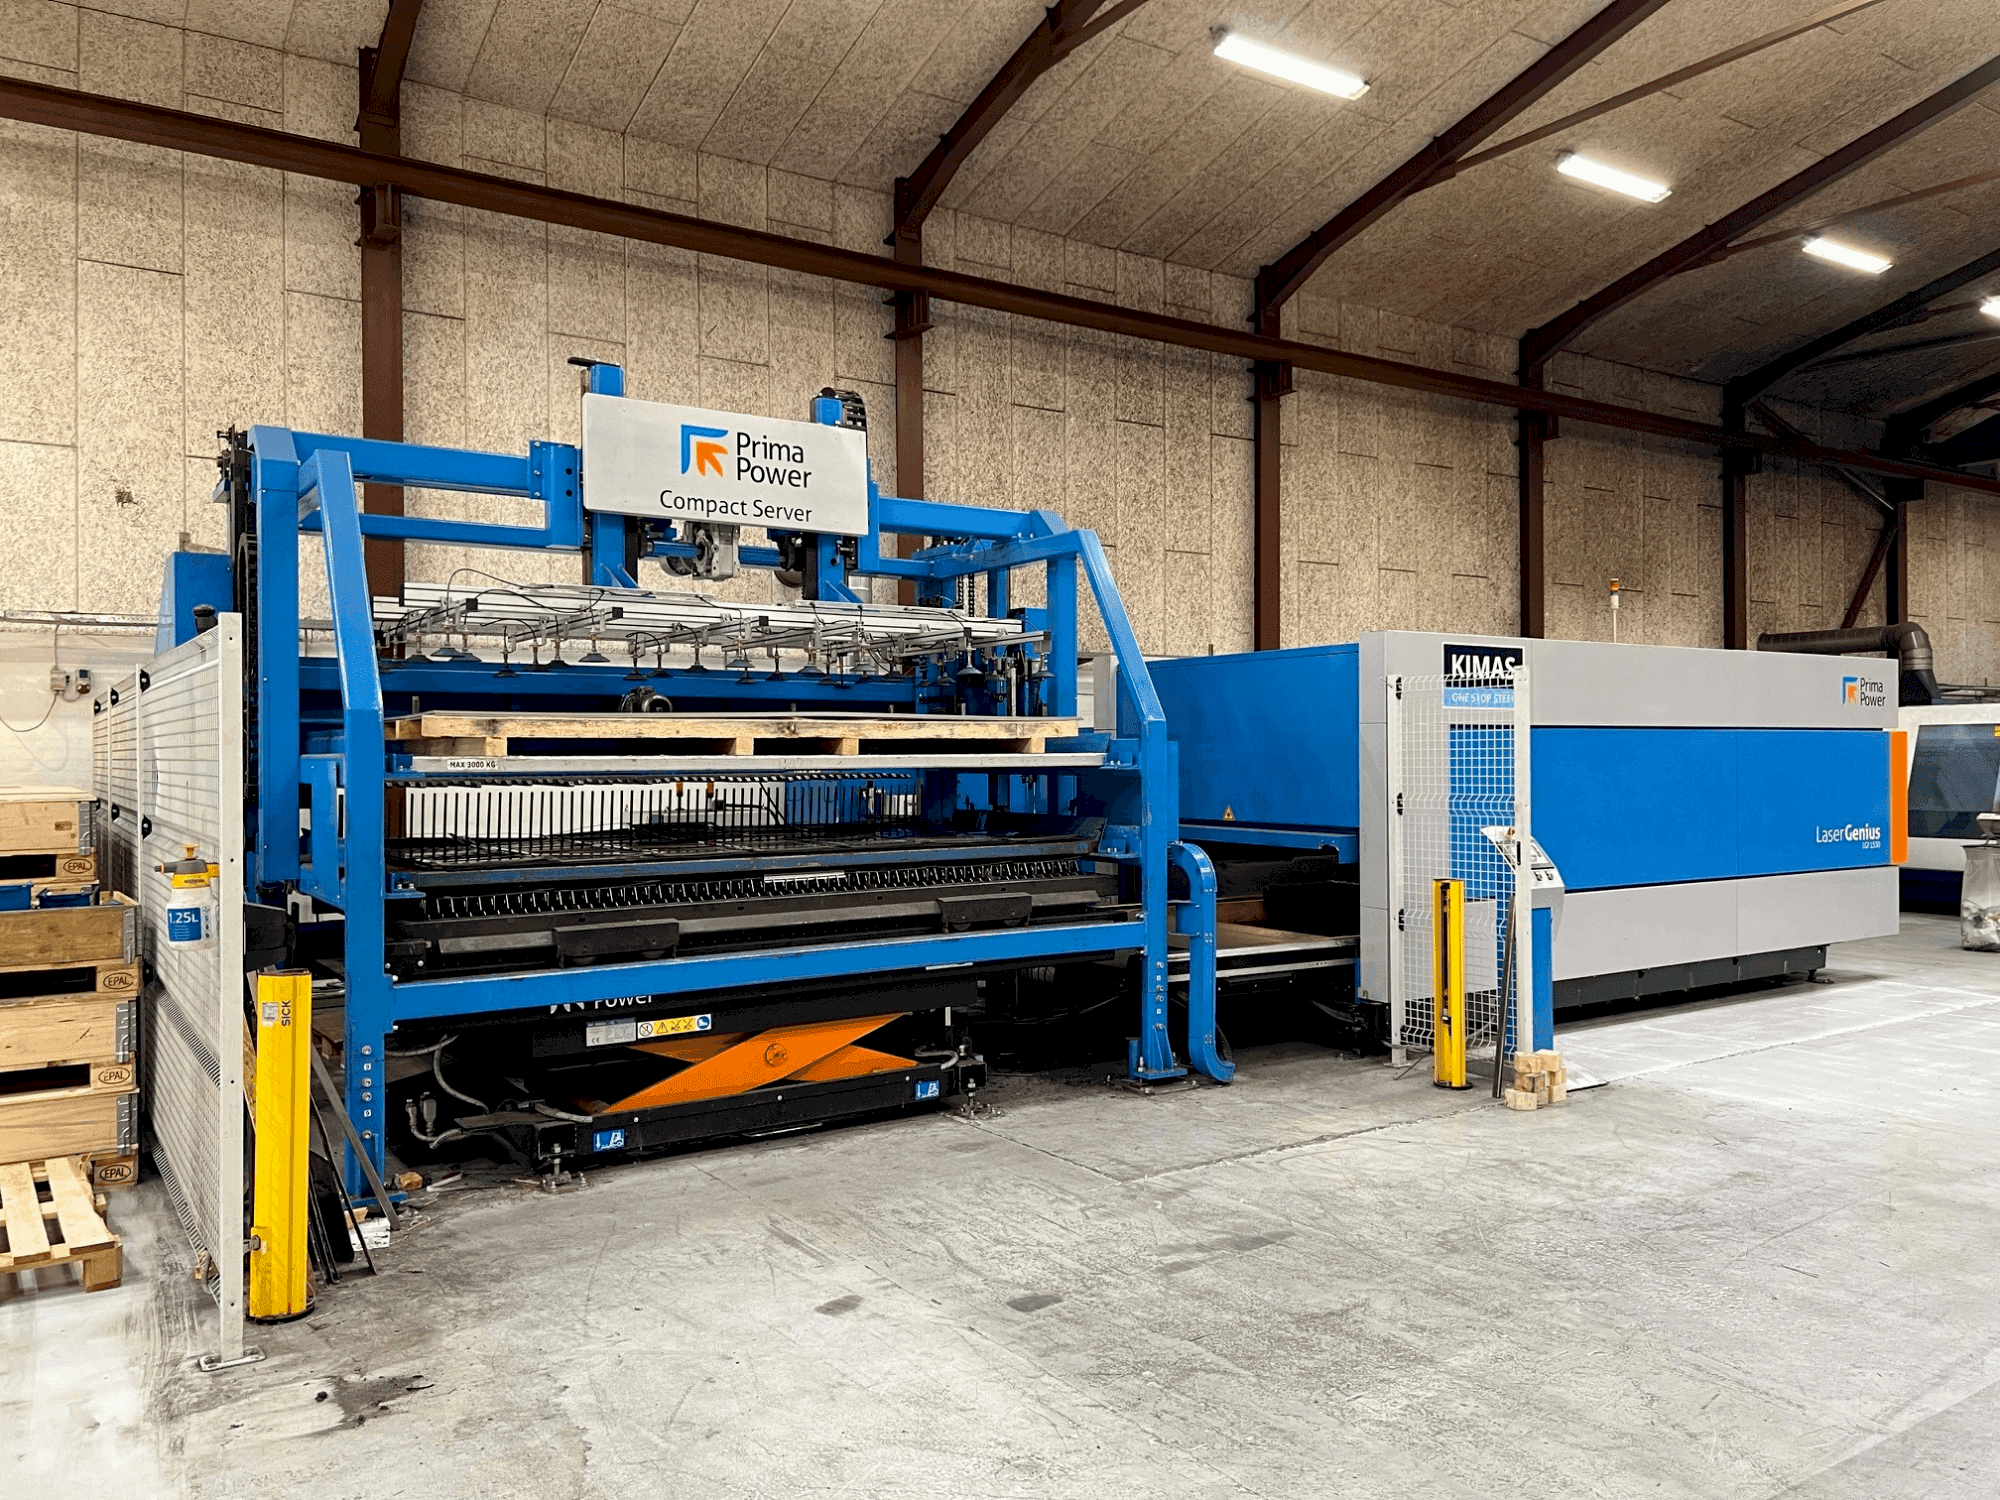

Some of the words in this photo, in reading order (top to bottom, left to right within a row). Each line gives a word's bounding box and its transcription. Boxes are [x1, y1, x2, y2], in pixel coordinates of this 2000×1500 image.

[736, 431, 804, 463] Prima
[736, 456, 812, 488] Power
[659, 489, 747, 517] Compact
[752, 499, 812, 522] Server
[1451, 654, 1516, 680] KIMAS
[1860, 677, 1884, 693] Prima
[1860, 691, 1886, 707] Power
[1815, 823, 1881, 843] LaserGenius
[67, 862, 90, 871] EPAL
[168, 911, 199, 924] 1.25L
[107, 976, 130, 987] EPAL
[281, 1000, 291, 1027] SICK
[103, 1070, 126, 1081] EPAL
[104, 1167, 126, 1179] EPAL
